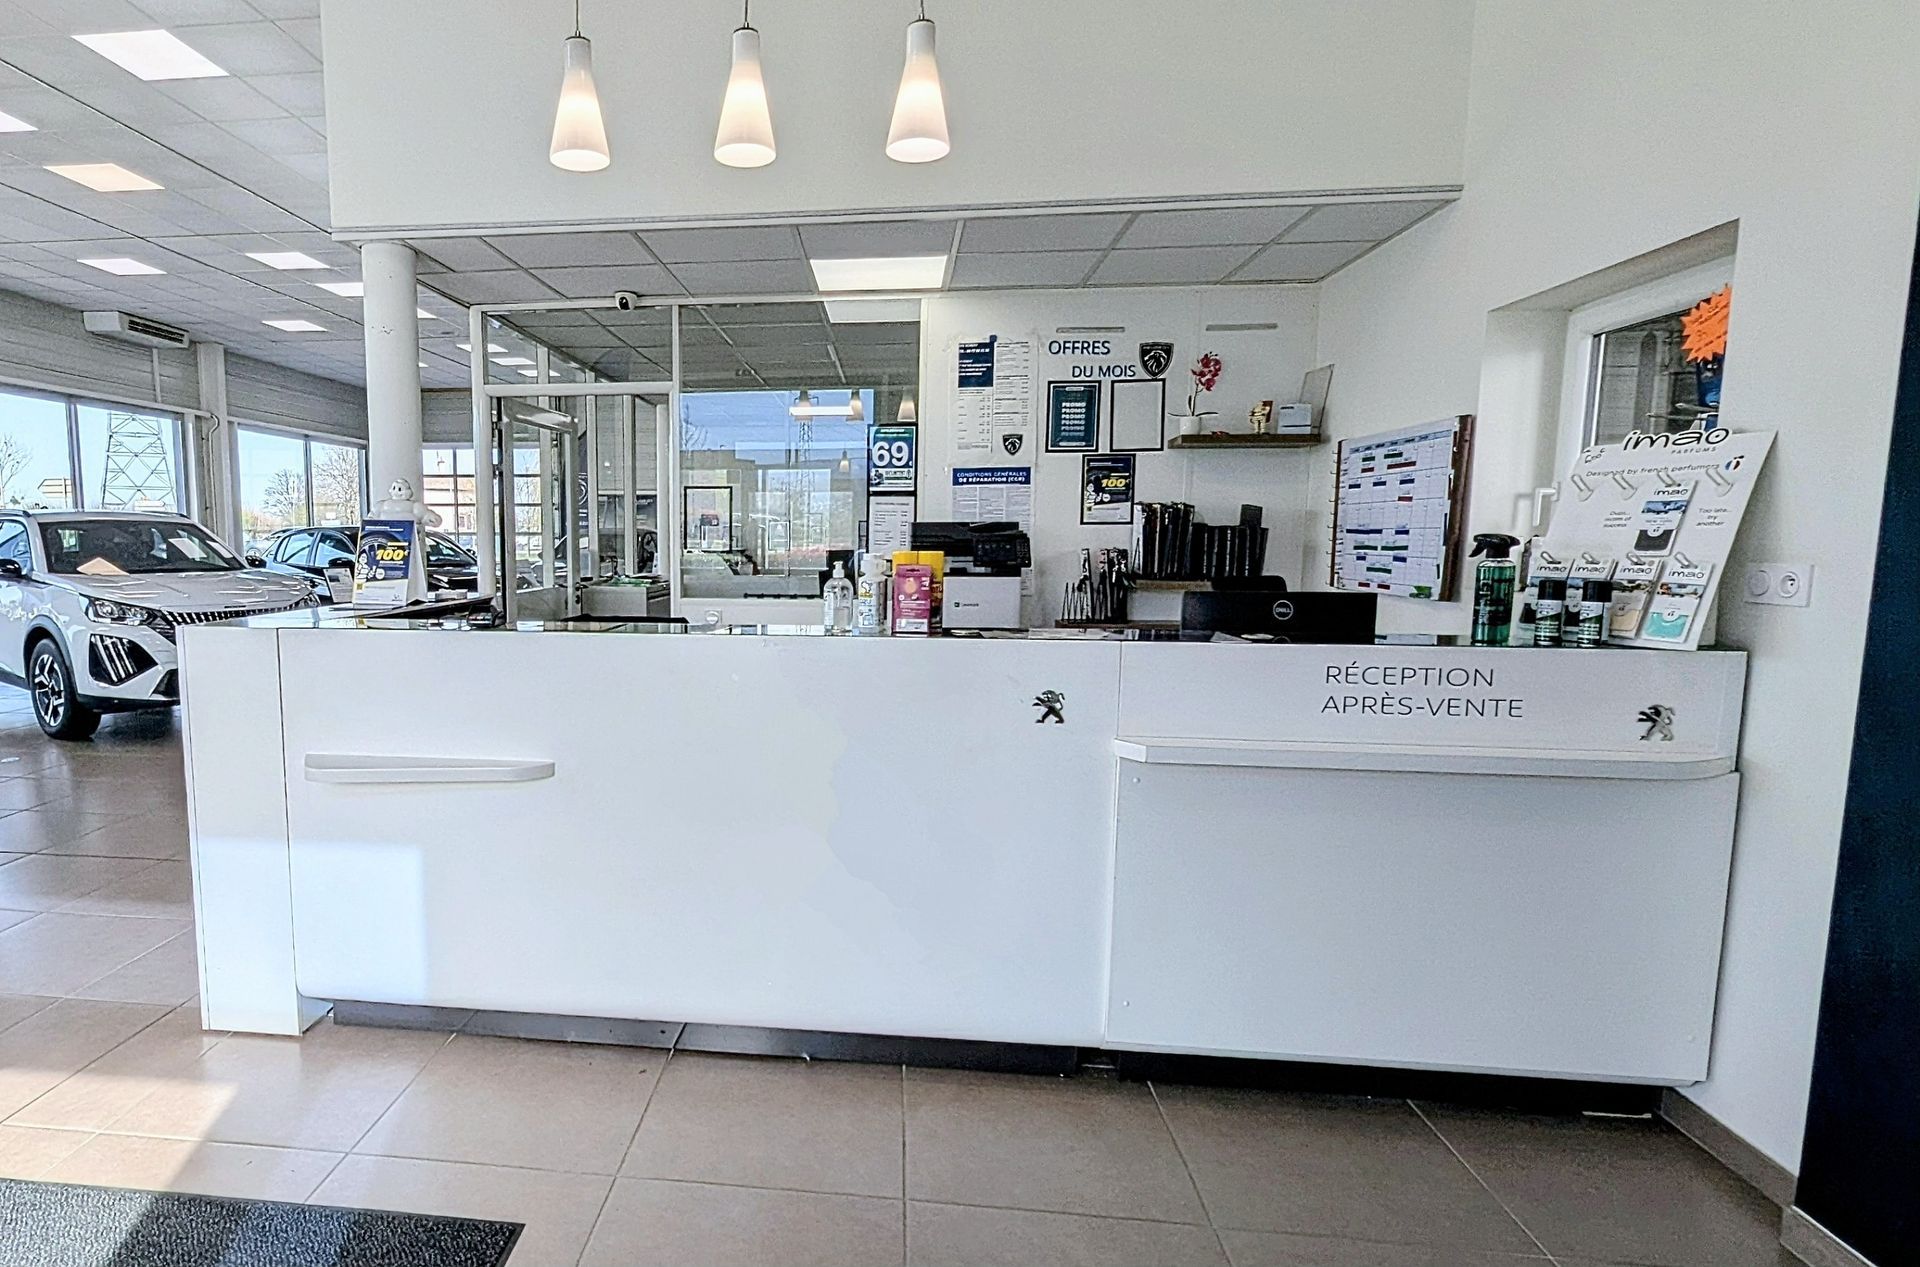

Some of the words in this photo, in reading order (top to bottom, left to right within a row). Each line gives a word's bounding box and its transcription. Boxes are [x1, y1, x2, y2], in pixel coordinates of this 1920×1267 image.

[1048, 340, 1111, 355] OFFRES
[1072, 365, 1094, 378] DU
[1098, 364, 1136, 378] MOIS
[1623, 427, 1730, 451] imao
[1586, 469, 1626, 478] Designed
[1626, 468, 1639, 476] by
[1641, 466, 1669, 474] french
[1671, 464, 1721, 473] perfumers
[1653, 488, 1689, 496] imao
[1536, 565, 1568, 573] imao
[1574, 565, 1607, 573] imao
[1619, 565, 1653, 575] imao
[1668, 569, 1705, 579] imao
[1325, 661, 1494, 687] RÉCEPTION
[1321, 691, 1523, 717] APRÈS-VENTE
